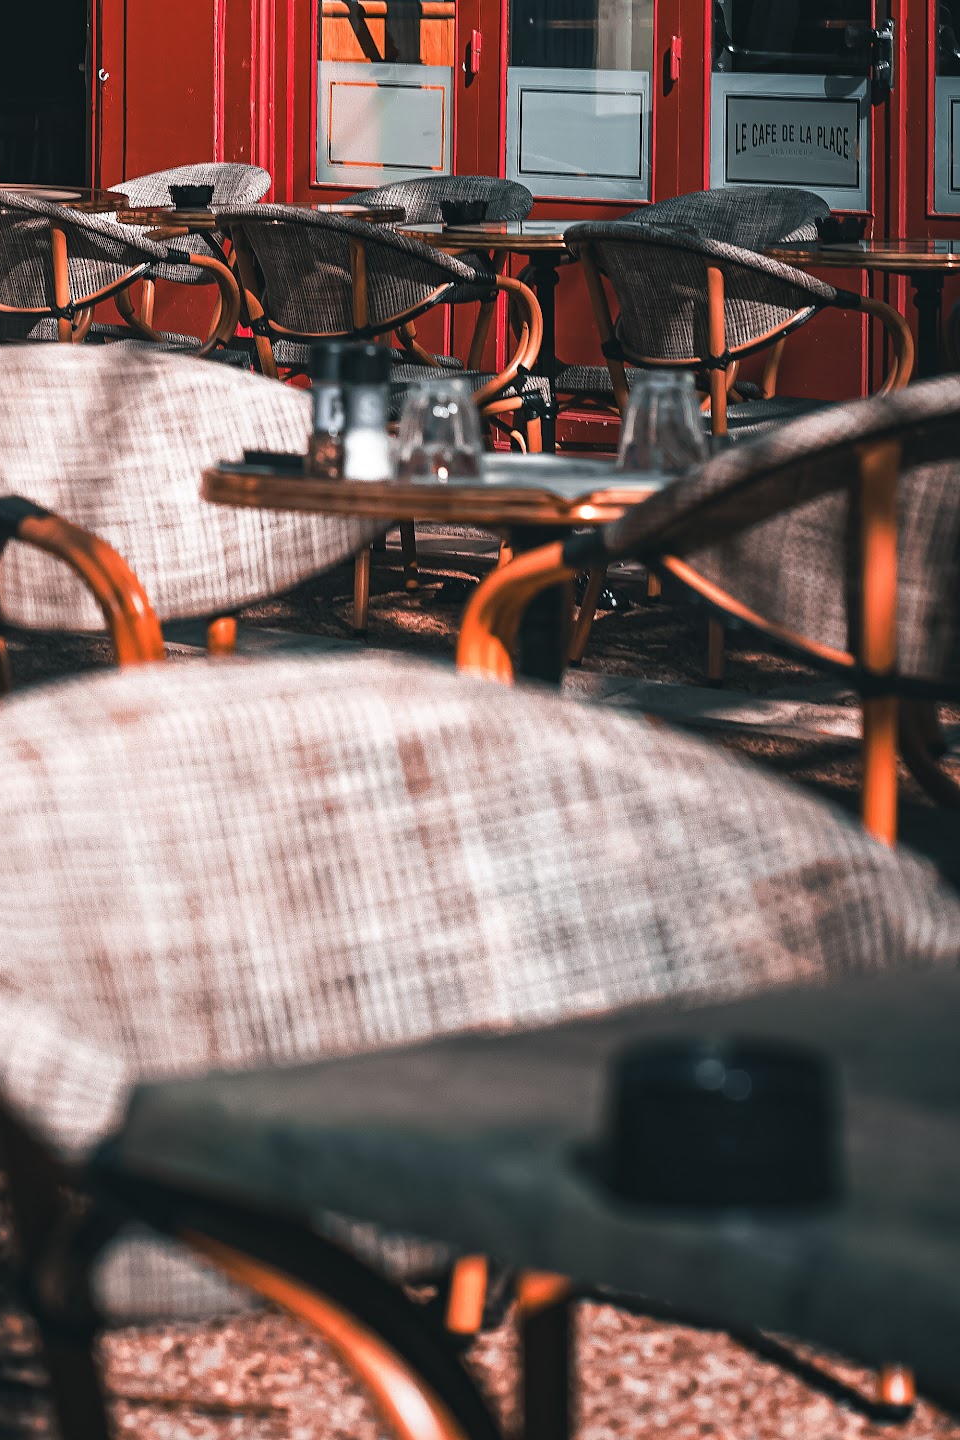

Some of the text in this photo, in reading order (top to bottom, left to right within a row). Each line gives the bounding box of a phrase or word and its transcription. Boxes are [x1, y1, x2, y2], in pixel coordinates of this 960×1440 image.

[735, 123, 849, 160] LE CAFE DE LA PLACE
